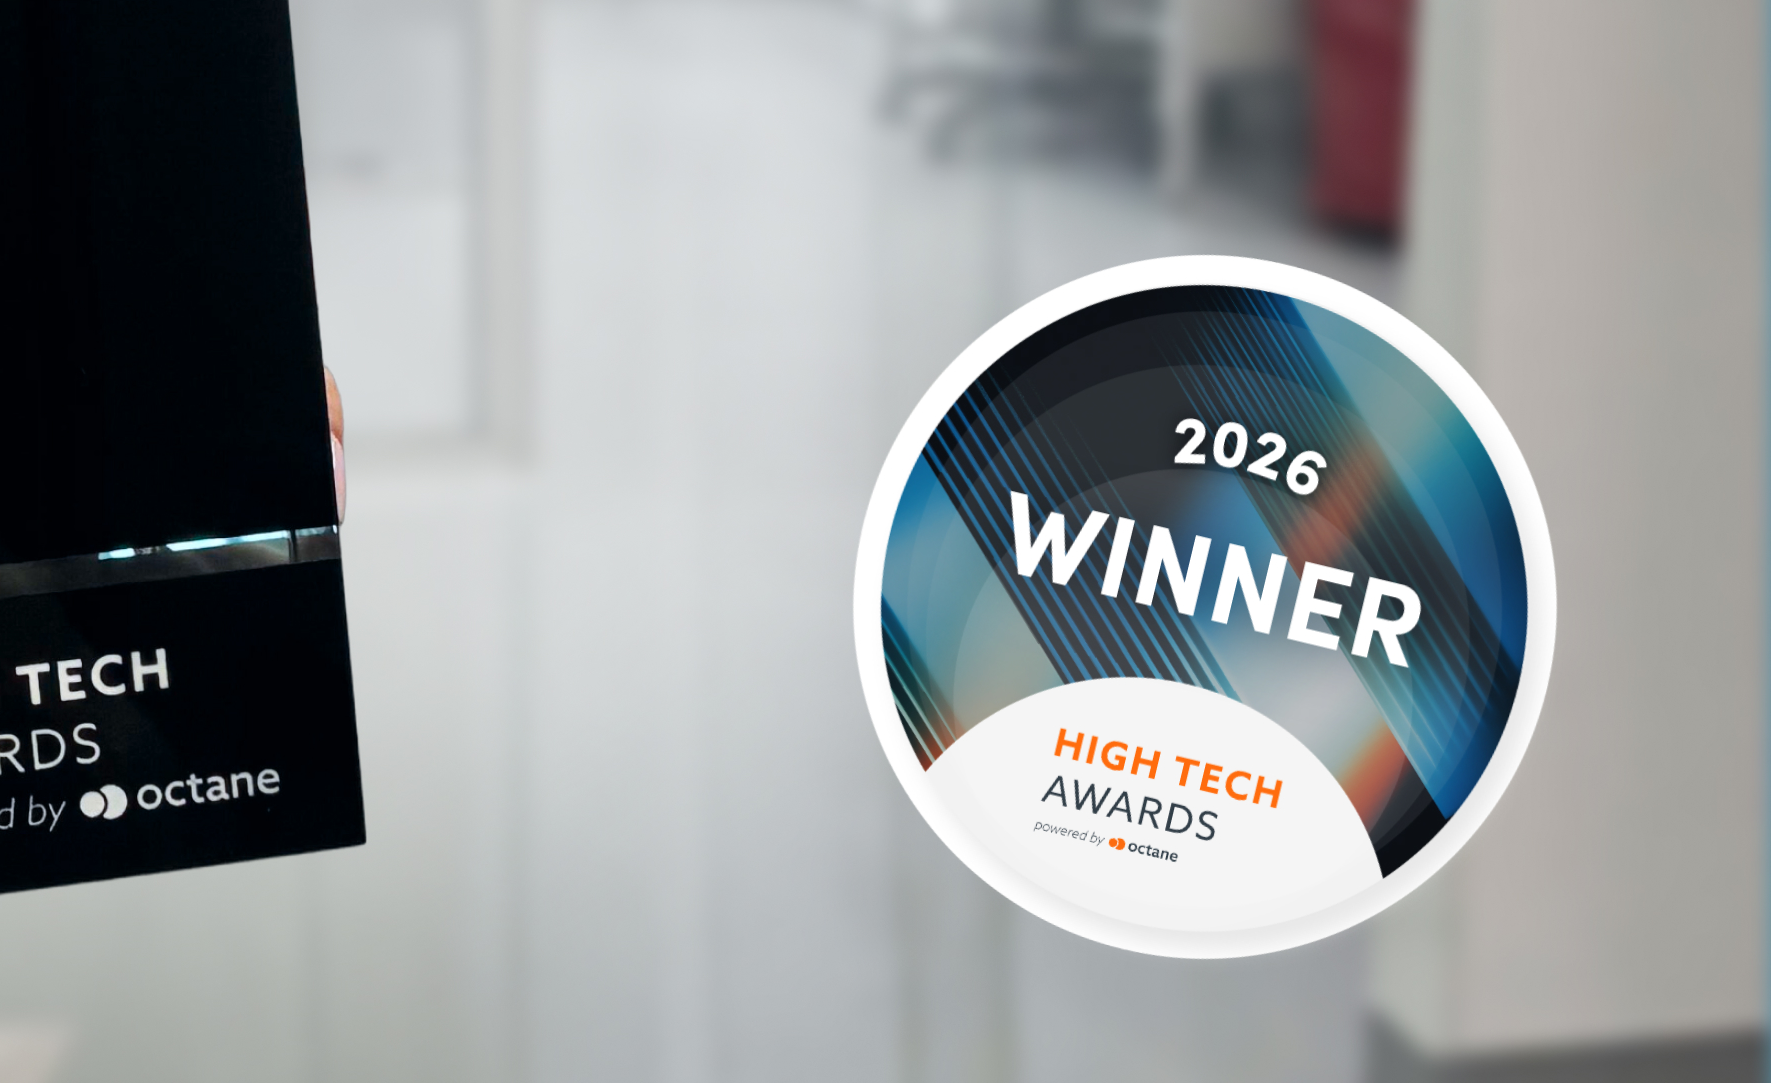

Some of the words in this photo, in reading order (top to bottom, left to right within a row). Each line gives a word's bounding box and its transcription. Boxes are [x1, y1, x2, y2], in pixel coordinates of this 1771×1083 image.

[15, 647, 171, 705] TECH
[28, 794, 66, 832] by
[137, 767, 281, 810] octane
